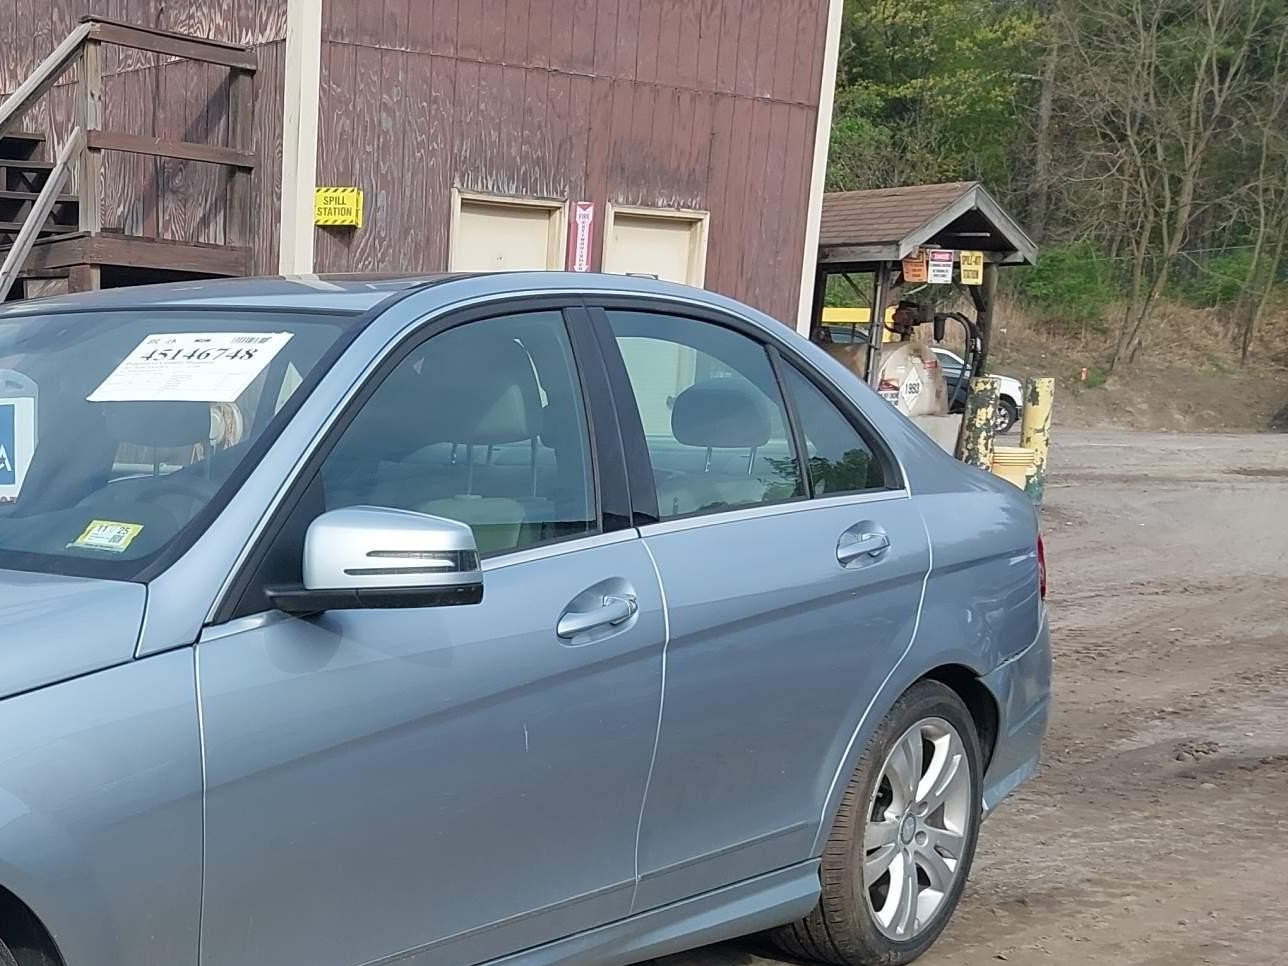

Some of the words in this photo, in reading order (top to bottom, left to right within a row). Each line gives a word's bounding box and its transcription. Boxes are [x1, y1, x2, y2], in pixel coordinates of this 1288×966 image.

[322, 195, 347, 206] SPILL
[316, 206, 353, 217] STATION
[140, 347, 258, 362] 45146748
[904, 382, 921, 395] 1993
